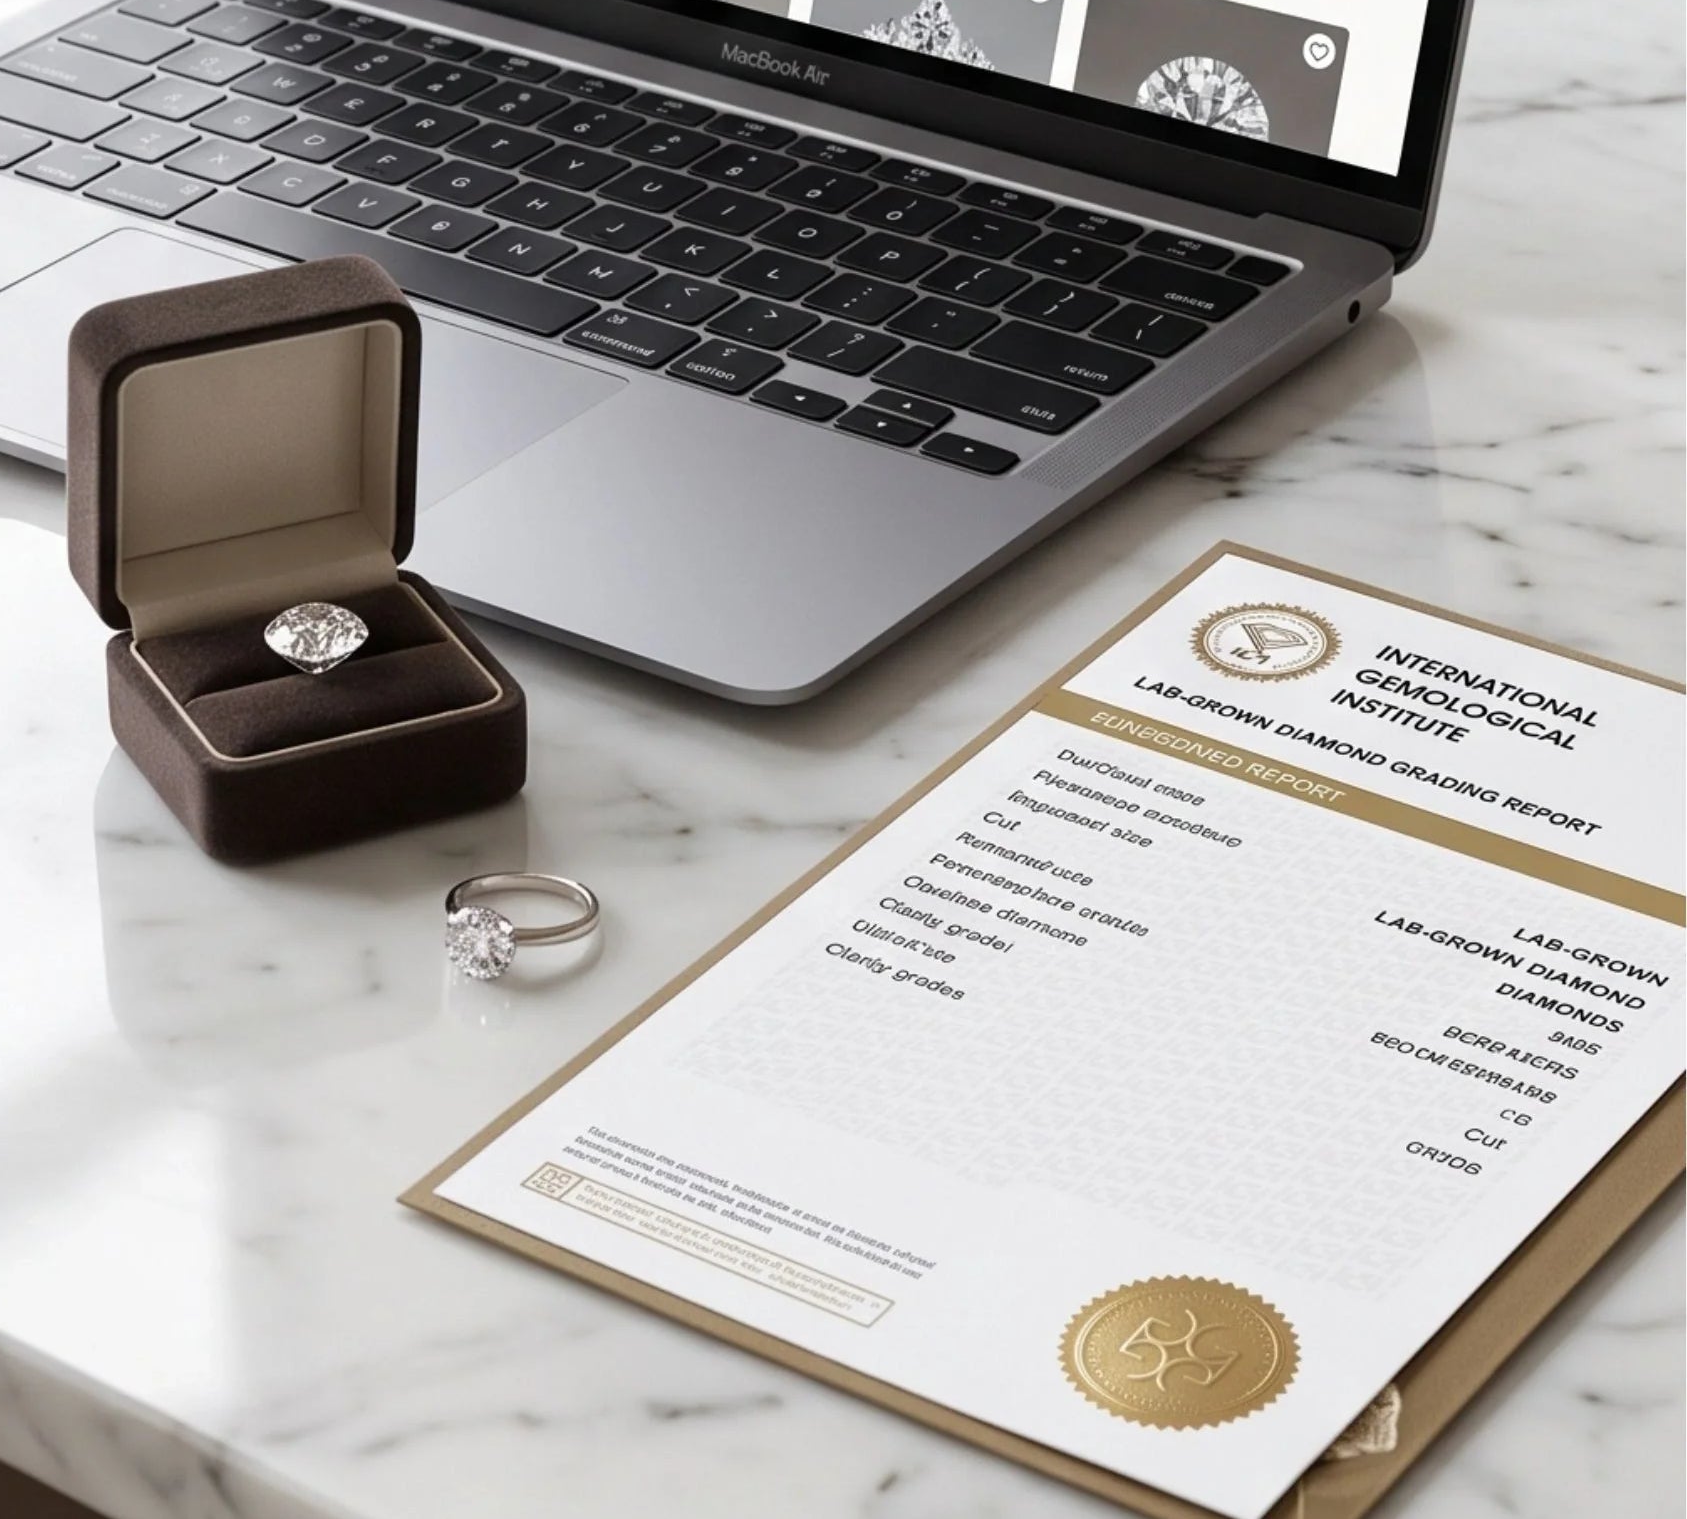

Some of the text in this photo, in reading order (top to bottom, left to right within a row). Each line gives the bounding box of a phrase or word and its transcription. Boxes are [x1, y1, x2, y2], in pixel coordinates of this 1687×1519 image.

[721, 41, 831, 85] MacBook Air
[1330, 688, 1470, 744] INSTITUTE
[1355, 668, 1577, 751] GEMOLOGICAL
[1375, 645, 1599, 728] INTERNATIONAL
[1133, 676, 1603, 837] LAB-GROWN DIAMOND GRADING REPORT
[1245, 763, 1347, 803] REPORT
[1374, 910, 1646, 1011] LAB-GROWN DIAMOND
[1513, 928, 1670, 988] LAB-GROWN
[1495, 982, 1625, 1034] DIAMONDS
